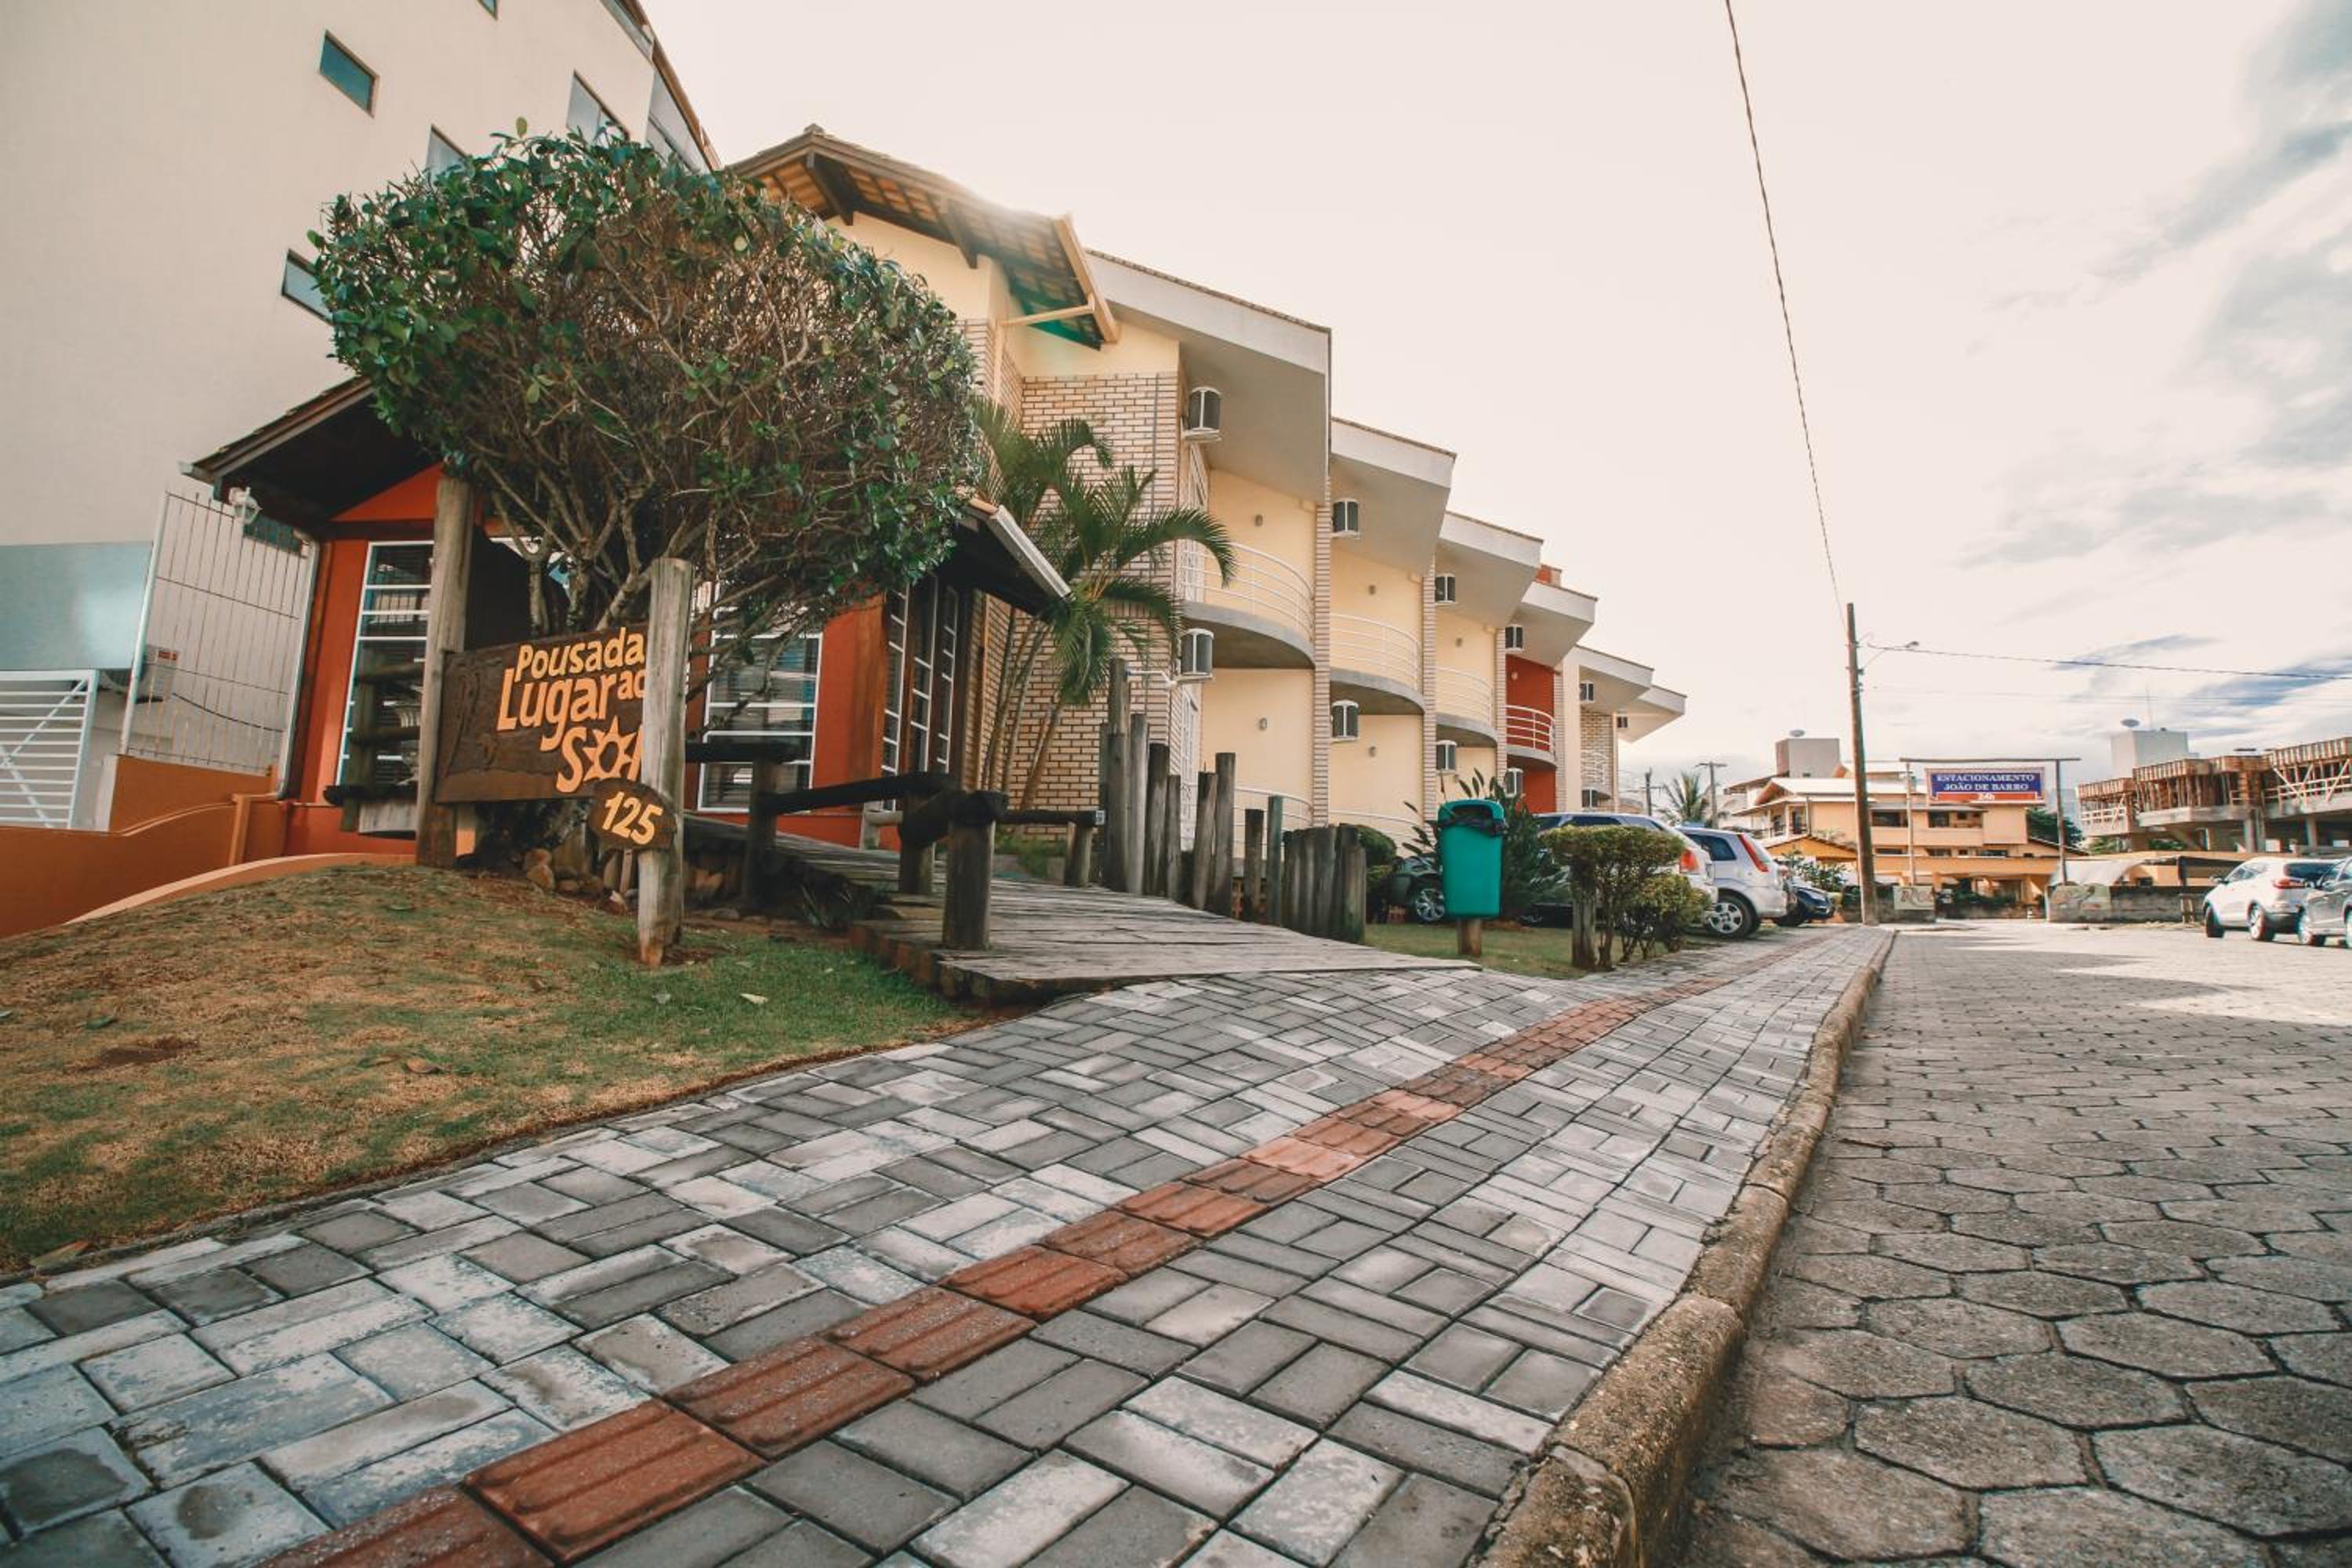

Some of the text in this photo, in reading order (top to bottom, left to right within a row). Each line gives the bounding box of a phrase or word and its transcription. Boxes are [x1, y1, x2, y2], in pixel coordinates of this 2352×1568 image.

[515, 627, 645, 682] Pousada
[496, 667, 616, 751] Lugar
[1944, 782, 1973, 791] JOÃO
[601, 791, 663, 845] 125
